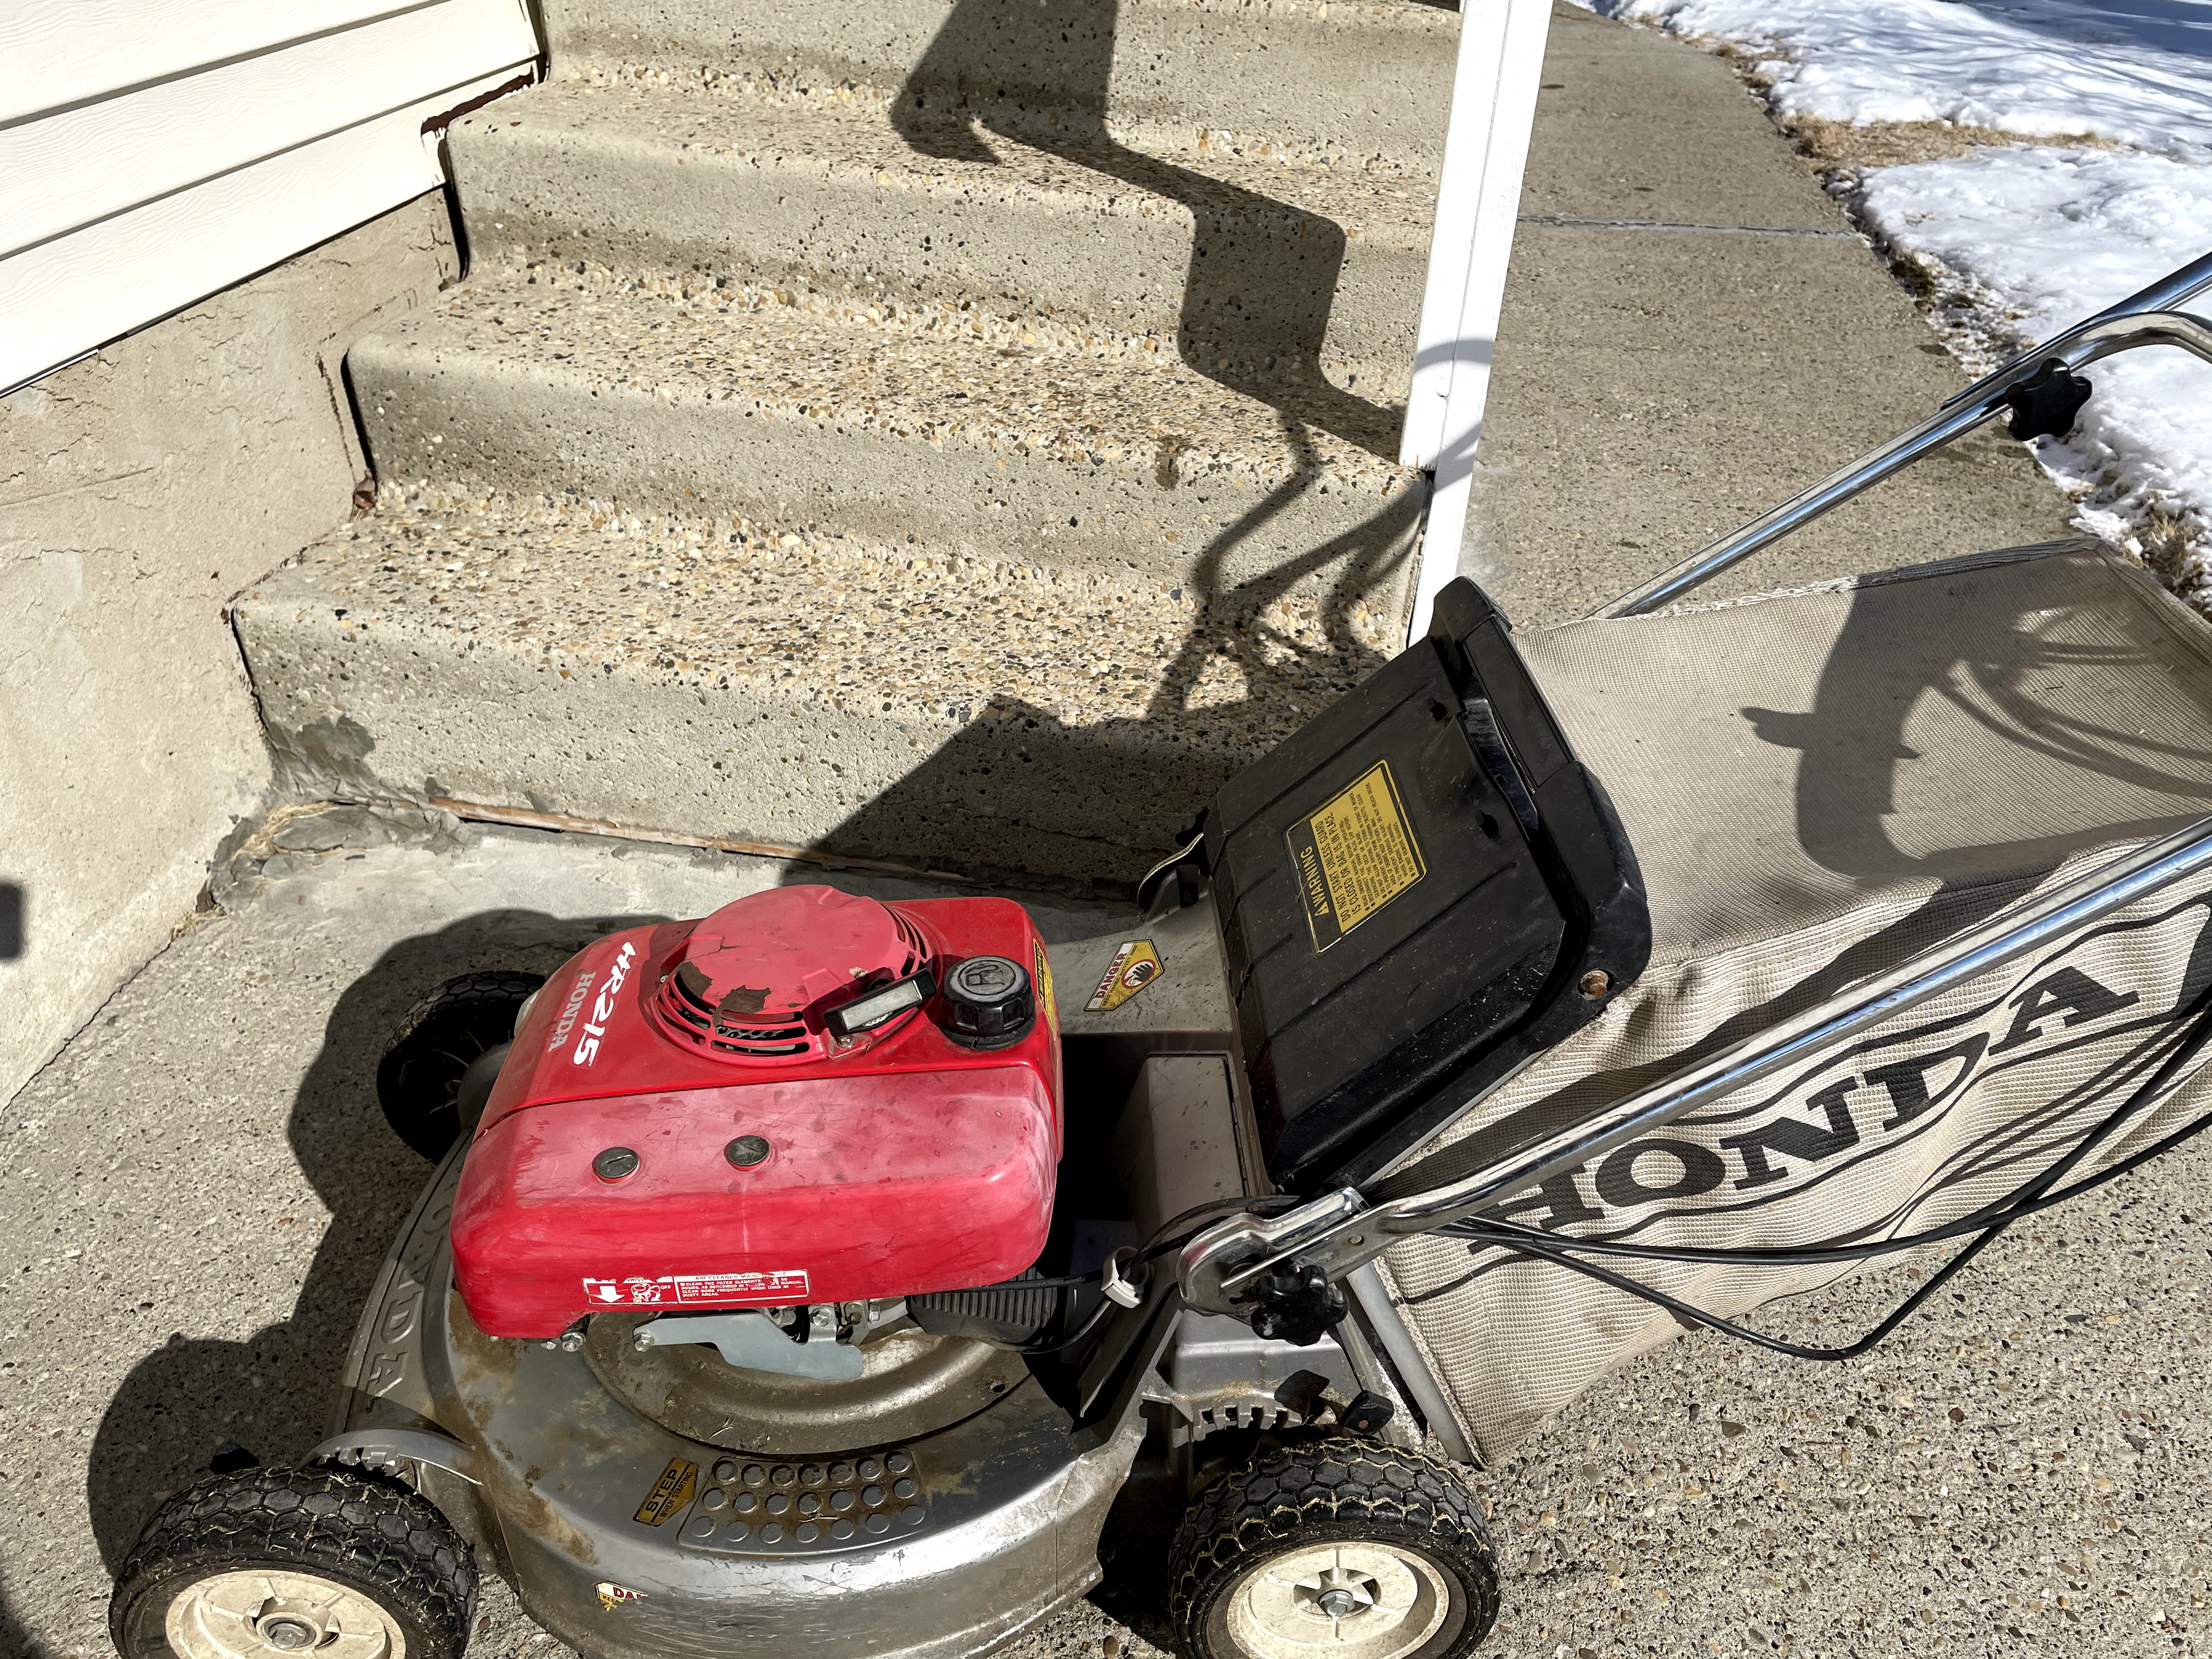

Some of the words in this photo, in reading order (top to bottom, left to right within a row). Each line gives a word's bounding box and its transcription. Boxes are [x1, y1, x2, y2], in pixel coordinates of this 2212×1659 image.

[1315, 821, 1328, 844] GUARD
[1324, 811, 1338, 836] PLACE.
[1343, 816, 1352, 831] BEFORE
[1330, 833, 1340, 844] IN
[1373, 827, 1382, 843] OTHERS
[1333, 842, 1342, 853] IS
[1345, 842, 1354, 859] BEFORE
[1367, 847, 1375, 864] ANYONE
[1384, 838, 1393, 856] SERIOUS
[1395, 848, 1404, 864] ENGINE
[1398, 839, 1408, 856] REMOVE
[1321, 843, 1336, 871] UNLESS
[1336, 850, 1347, 867] BAG
[1375, 851, 1383, 866] INJURY
[1390, 856, 1400, 874] PREVENT
[1301, 846, 1325, 906] WARNING
[1340, 866, 1350, 878] OR
[1351, 858, 1359, 876] MANUAL
[1372, 864, 1380, 878] ALLOW
[1380, 866, 1389, 884] PREVENT
[1408, 865, 1414, 873] DO
[1329, 870, 1342, 893] START
[1362, 877, 1374, 902] DISCONNECT
[1369, 876, 1380, 898] SERVICING
[1344, 877, 1358, 905] CLOSED
[1335, 893, 1347, 910] NOT
[1351, 904, 1362, 915] IS
[1340, 909, 1351, 923] DO
[1094, 953, 1127, 998] DANGER
[1109, 977, 1121, 993] HANDS
[1122, 957, 1131, 968] FEET
[548, 972, 596, 1052] HONDA
[574, 942, 636, 1066] HR215
[645, 1469, 678, 1513] STEP
[659, 1499, 675, 1517] WHEN
[672, 1471, 693, 1498] STARTING
